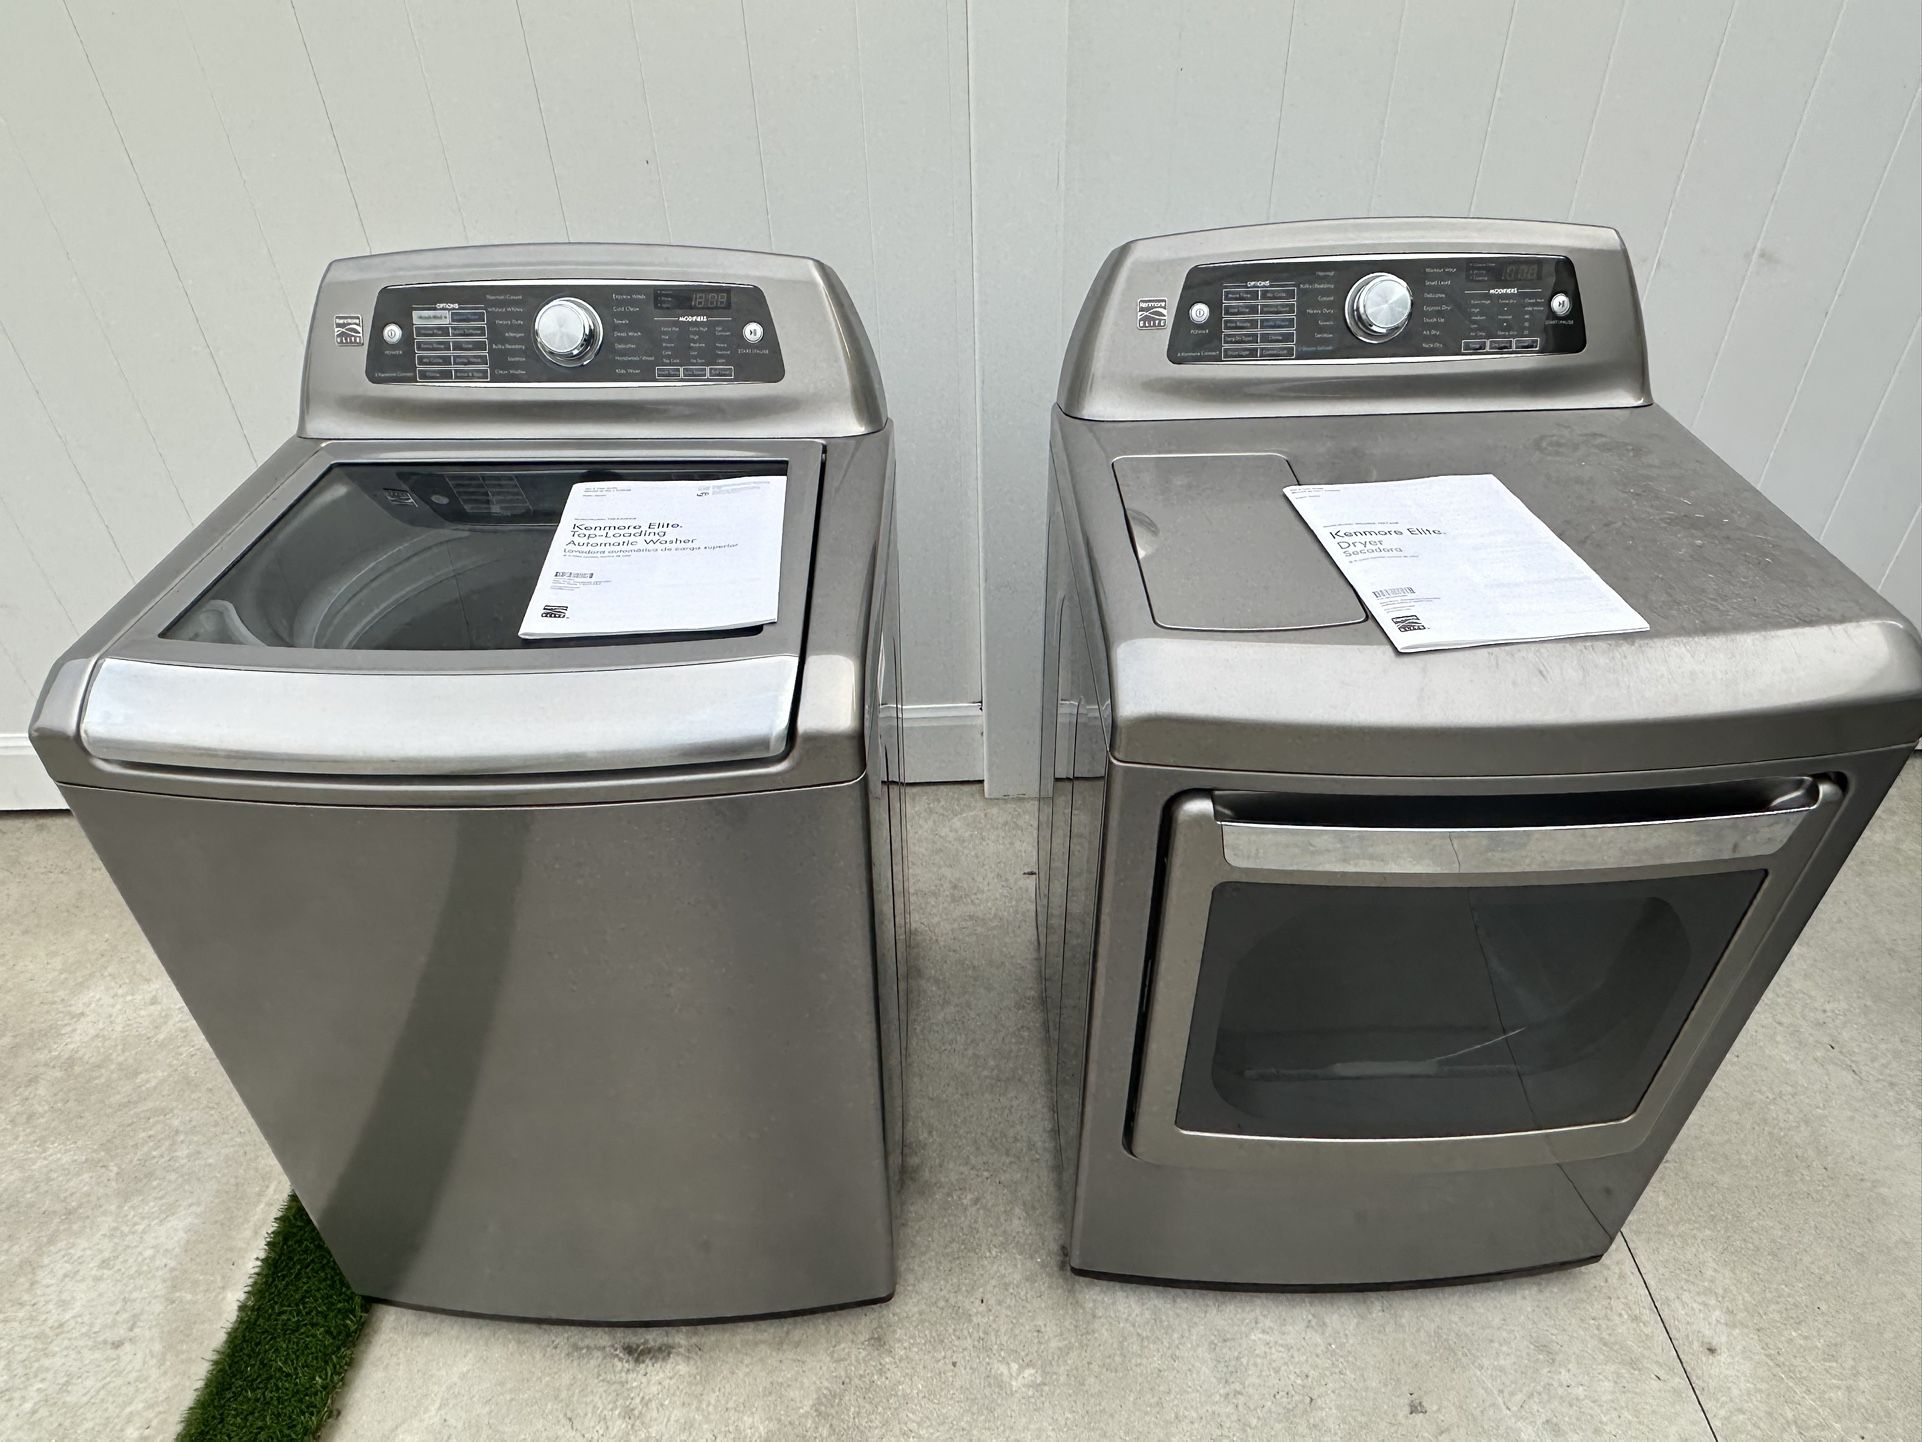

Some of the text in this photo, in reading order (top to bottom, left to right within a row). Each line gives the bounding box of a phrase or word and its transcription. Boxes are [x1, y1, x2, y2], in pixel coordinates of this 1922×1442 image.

[1139, 319, 1166, 327] ELITE
[572, 523, 642, 531] Kenmore
[570, 530, 667, 539] Top-Loading
[1329, 527, 1404, 540] Kenmore
[566, 537, 697, 548] Automatic Washer
[1337, 539, 1385, 550] Dryer
[1343, 546, 1404, 558] Secadora
